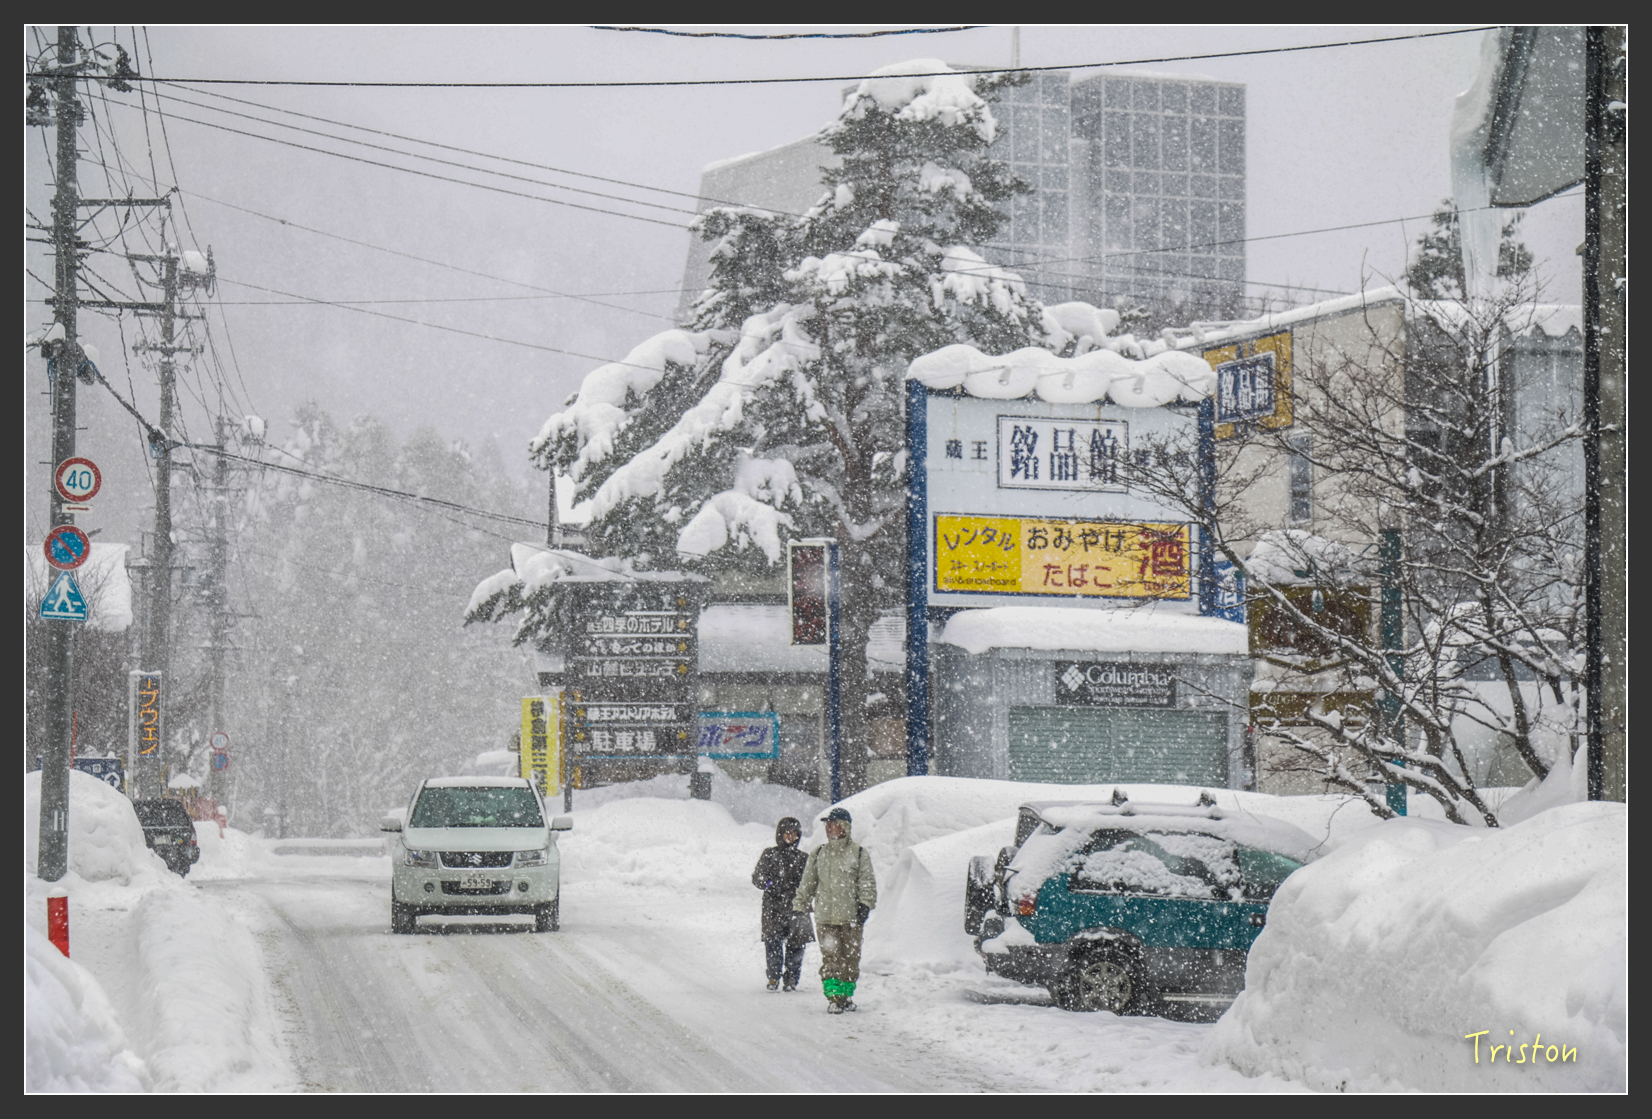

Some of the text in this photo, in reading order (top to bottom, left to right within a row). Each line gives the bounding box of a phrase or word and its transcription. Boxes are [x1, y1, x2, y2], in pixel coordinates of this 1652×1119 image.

[66, 470, 91, 490] 40
[943, 526, 1016, 551] レンタル
[1027, 526, 1126, 553] おみやげ
[1139, 530, 1184, 577] 酒
[1043, 563, 1113, 588] たばこ
[1086, 665, 1169, 687] Columbia
[591, 730, 657, 752] 駐車場
